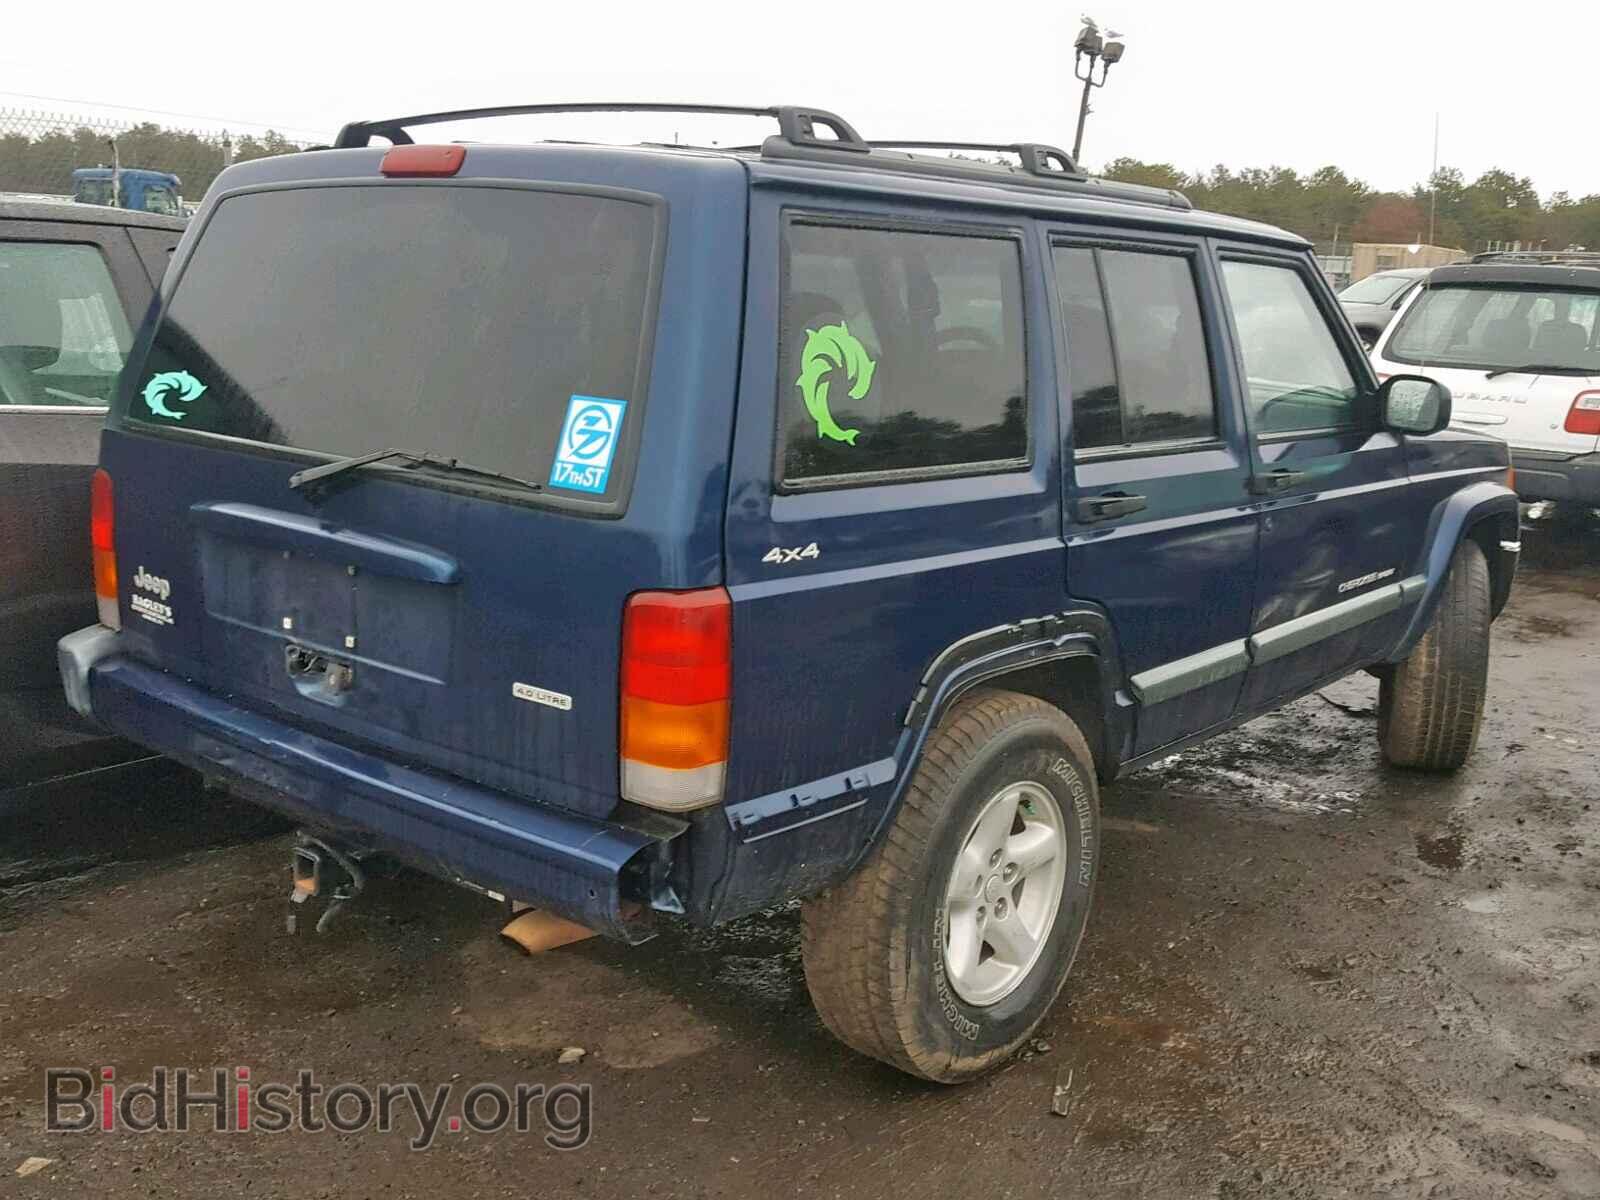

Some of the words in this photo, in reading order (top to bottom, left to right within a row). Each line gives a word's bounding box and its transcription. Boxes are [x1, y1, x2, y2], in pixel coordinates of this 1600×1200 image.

[1451, 392, 1527, 404] UBARU
[132, 564, 171, 601] Jeep
[537, 690, 568, 707] LITRE
[1051, 757, 1093, 887] MICHELIN
